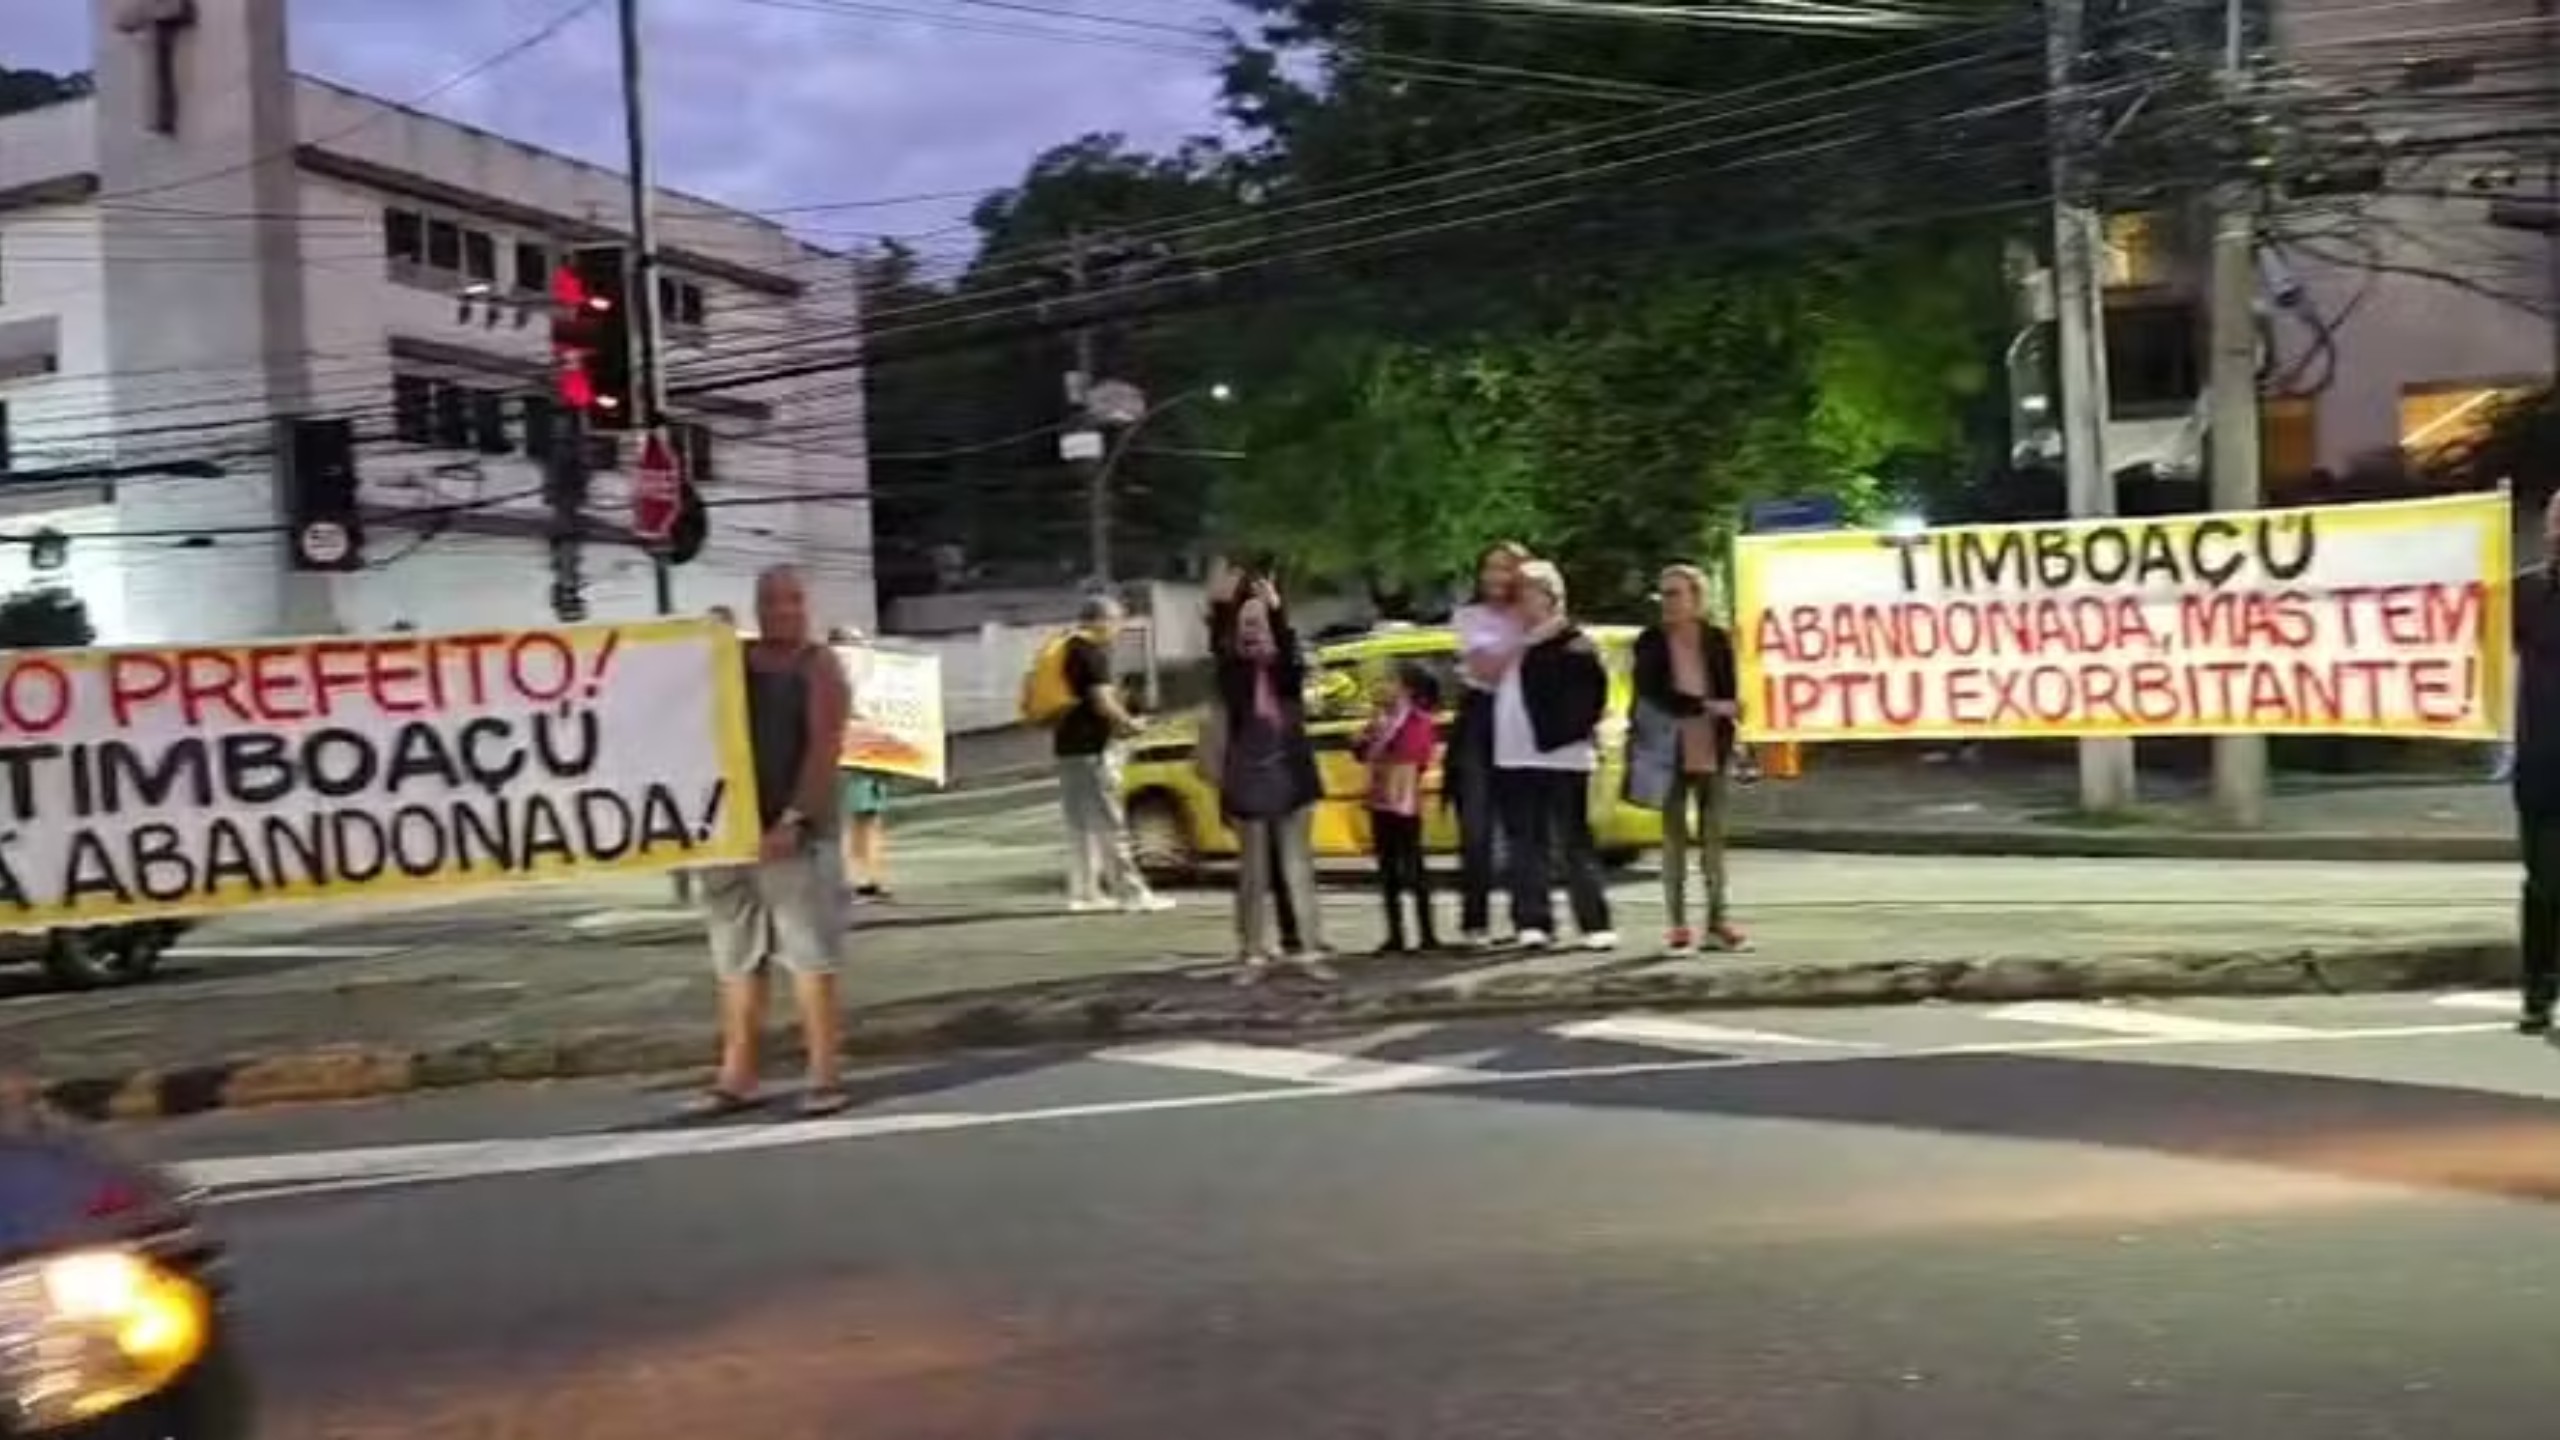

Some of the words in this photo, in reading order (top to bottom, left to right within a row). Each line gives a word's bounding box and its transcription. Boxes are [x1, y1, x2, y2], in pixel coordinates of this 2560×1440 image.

[1755, 595, 2174, 663] ABANDONADA,
[2180, 589, 2316, 650] MAS
[2328, 581, 2487, 648] TEM
[0, 658, 71, 732] O
[109, 631, 619, 726] PREFEITO!
[1763, 671, 1925, 729] IPTU
[1944, 656, 2476, 724] EXORBITANTE!
[62, 778, 727, 908] ABANDONADA!
